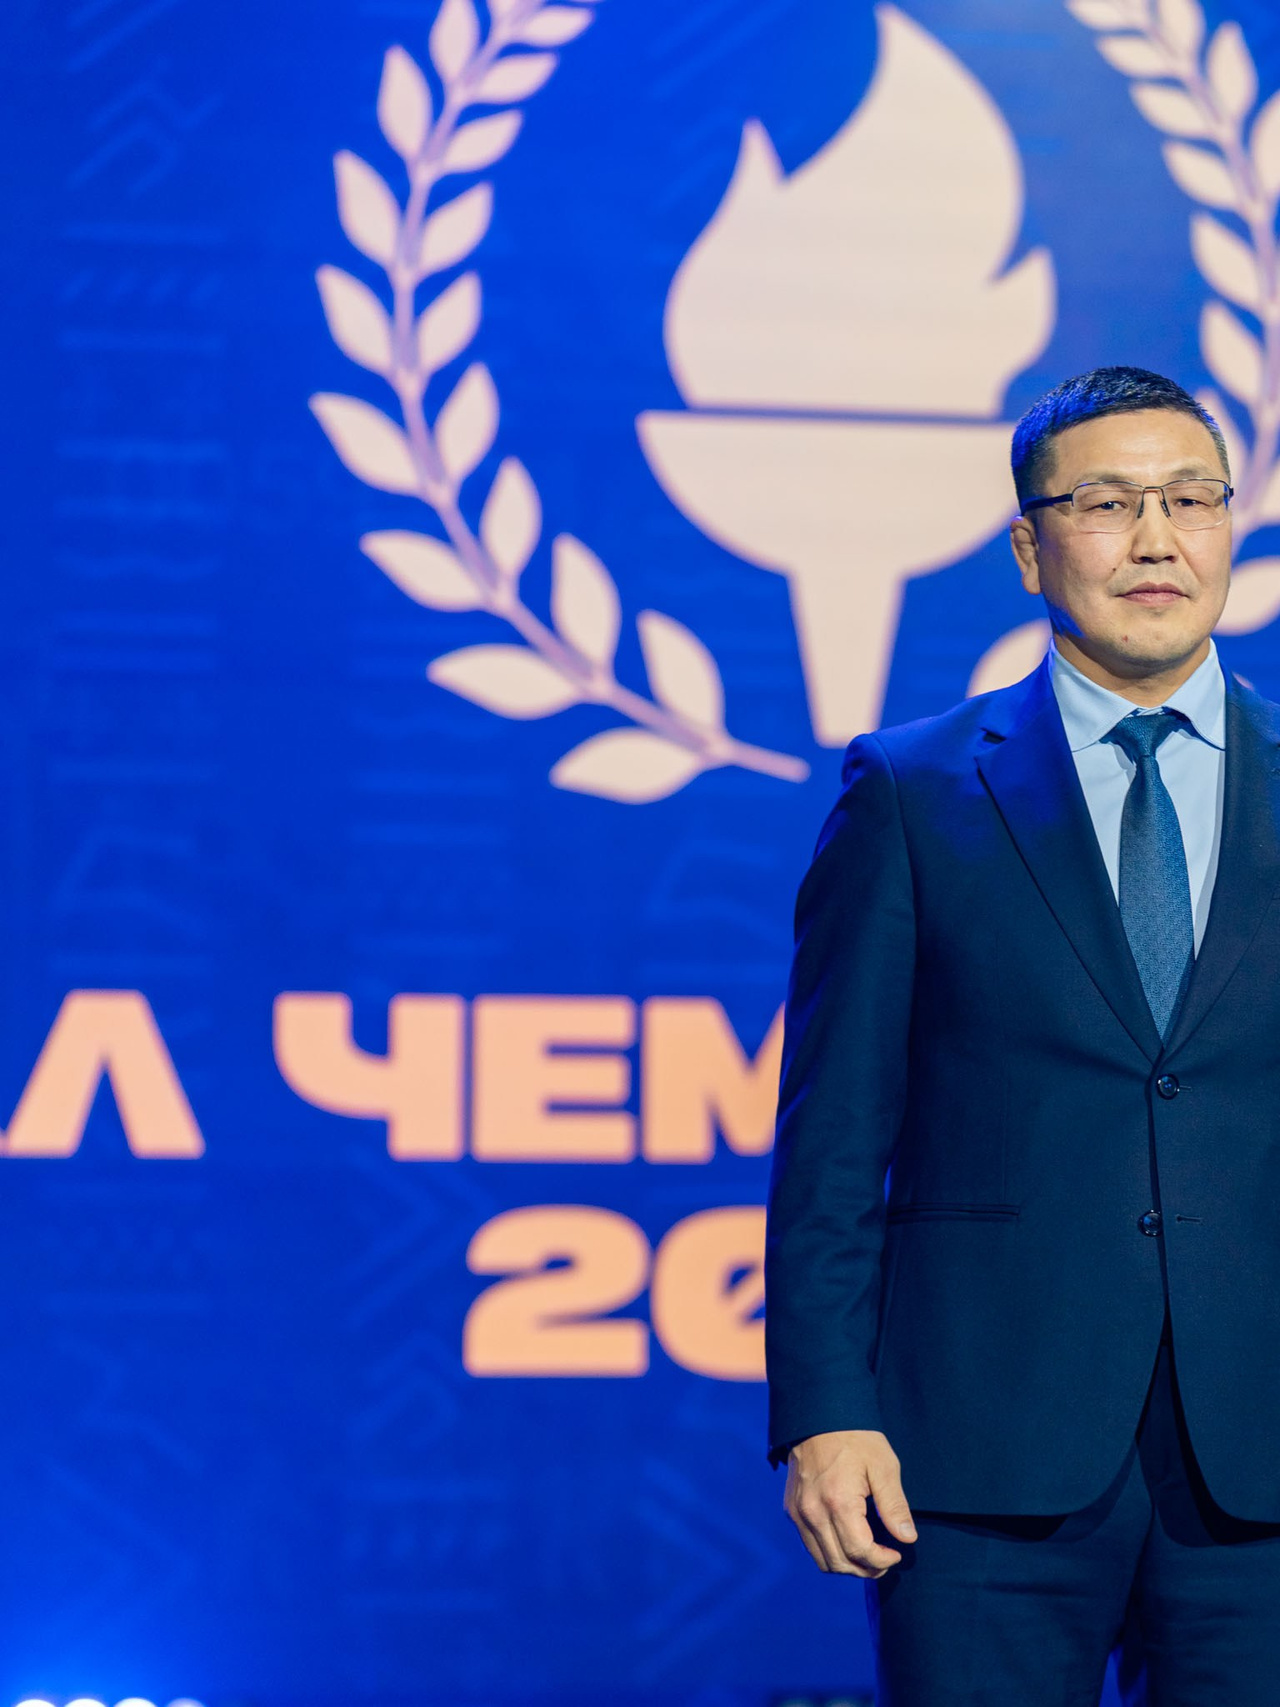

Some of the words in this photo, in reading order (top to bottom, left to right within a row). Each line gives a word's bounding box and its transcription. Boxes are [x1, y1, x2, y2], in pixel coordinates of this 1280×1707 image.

[0, 989, 206, 1159] Л
[272, 991, 786, 1165] ЧЕМ
[462, 1204, 768, 1382] 20
